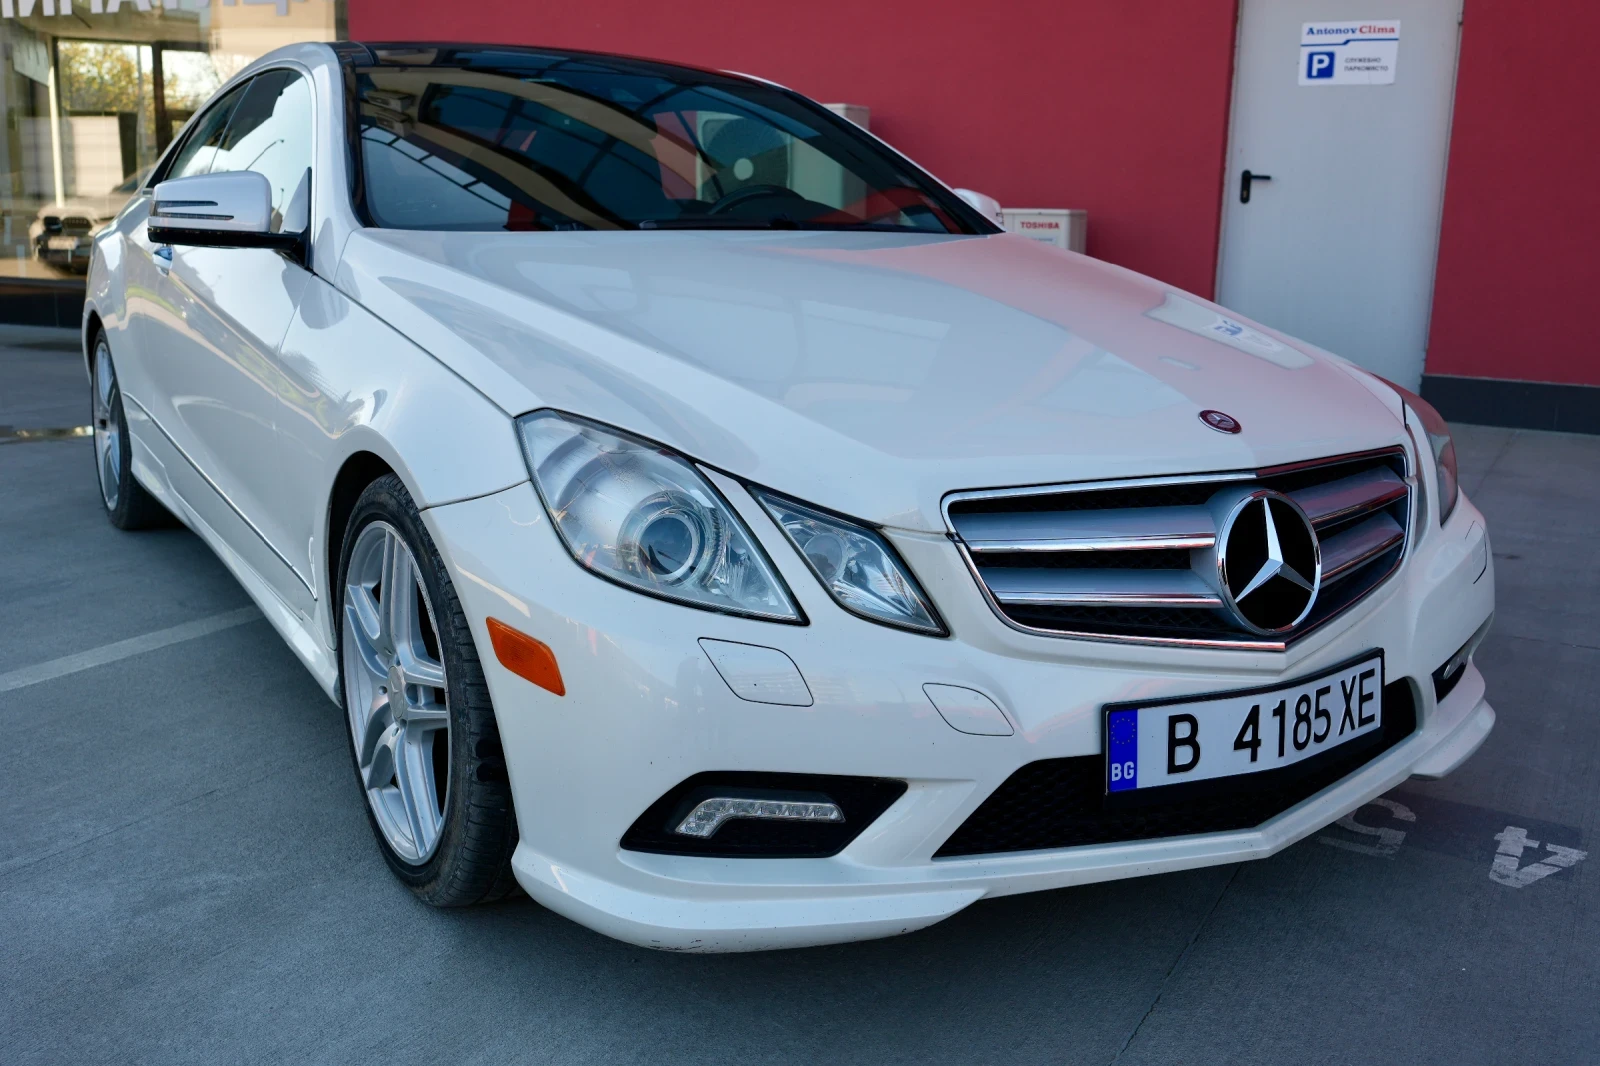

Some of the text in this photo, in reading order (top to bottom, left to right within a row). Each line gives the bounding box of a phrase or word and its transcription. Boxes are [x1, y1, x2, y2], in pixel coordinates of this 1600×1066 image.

[1311, 54, 1330, 77] P
[1020, 221, 1060, 230] TOSHIBA
[1167, 713, 1201, 775] B
[1111, 761, 1135, 782] BG
